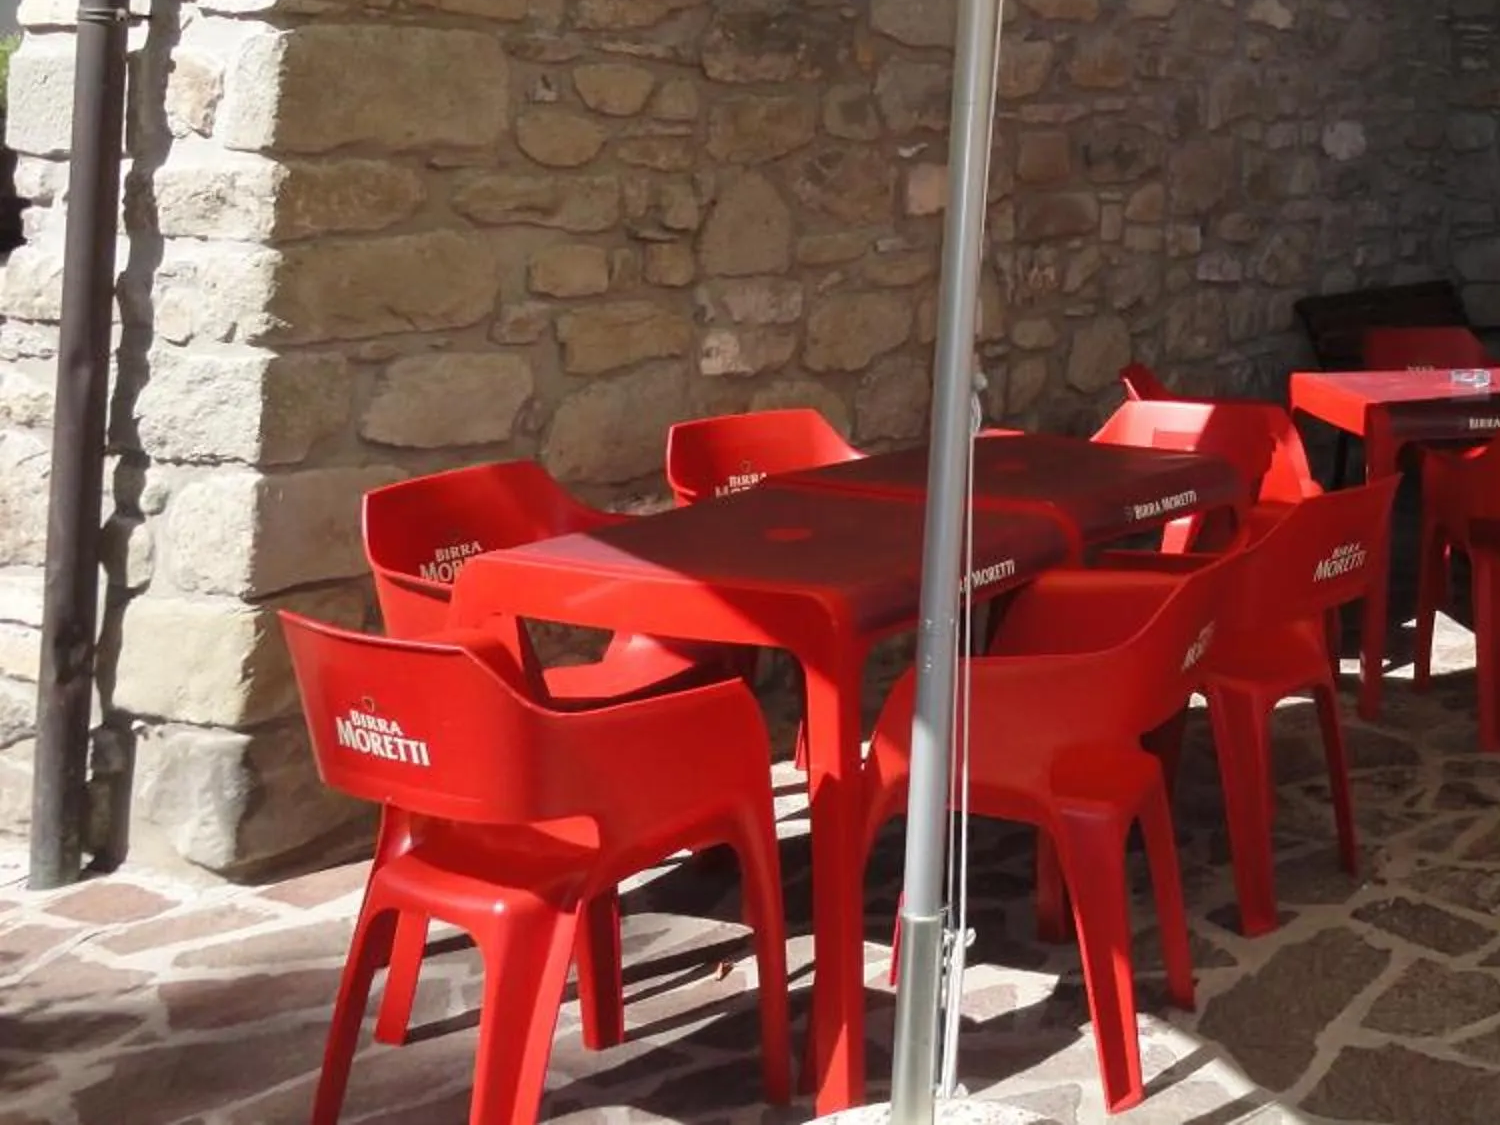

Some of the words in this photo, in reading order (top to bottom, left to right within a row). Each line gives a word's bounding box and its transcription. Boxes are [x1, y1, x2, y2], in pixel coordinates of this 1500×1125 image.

[435, 540, 482, 562] BIRRA
[349, 708, 404, 736] BIRRA
[336, 716, 431, 767] MORETTI
